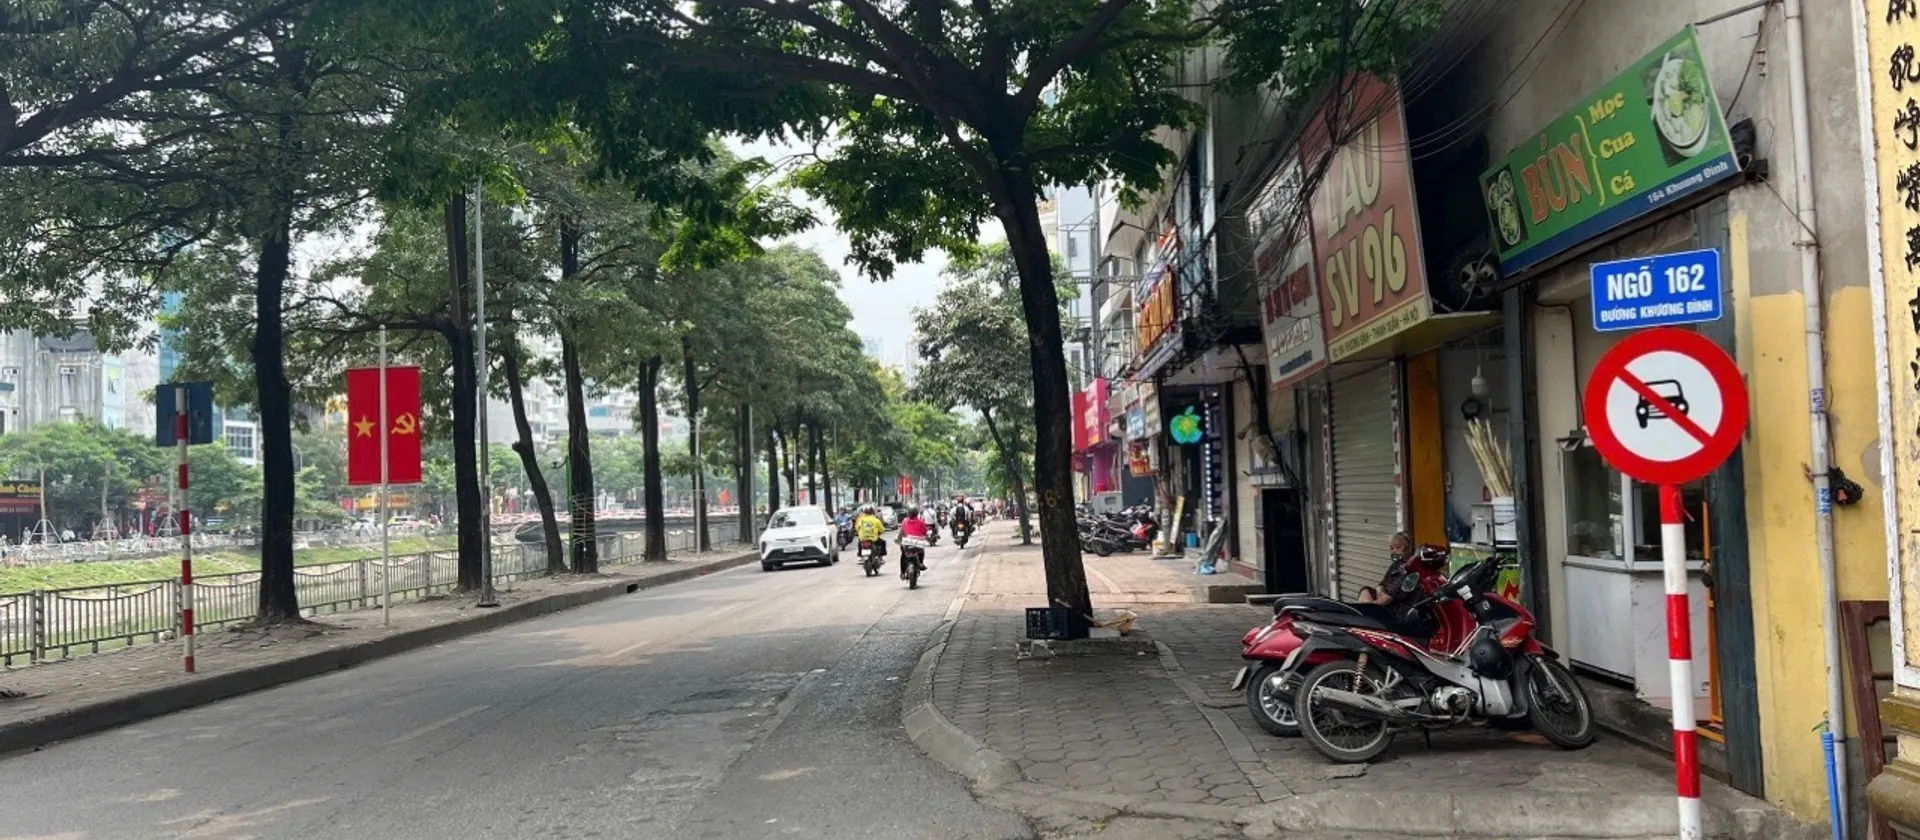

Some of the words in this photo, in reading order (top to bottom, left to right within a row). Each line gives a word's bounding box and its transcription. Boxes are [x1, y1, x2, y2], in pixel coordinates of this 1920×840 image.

[1588, 92, 1625, 124] Mọc
[1600, 131, 1635, 159] Cua
[1520, 133, 1592, 225] BÚN
[1610, 170, 1635, 196] Cá
[1325, 236, 1359, 328] SV
[1362, 206, 1408, 305] 96
[1607, 265, 1653, 301] NGÕ
[1664, 263, 1706, 294] 162
[1600, 304, 1637, 322] ĐƯỜNG
[1640, 302, 1685, 319] KHƯƠNG
[1686, 298, 1713, 314] ĐÌNH
